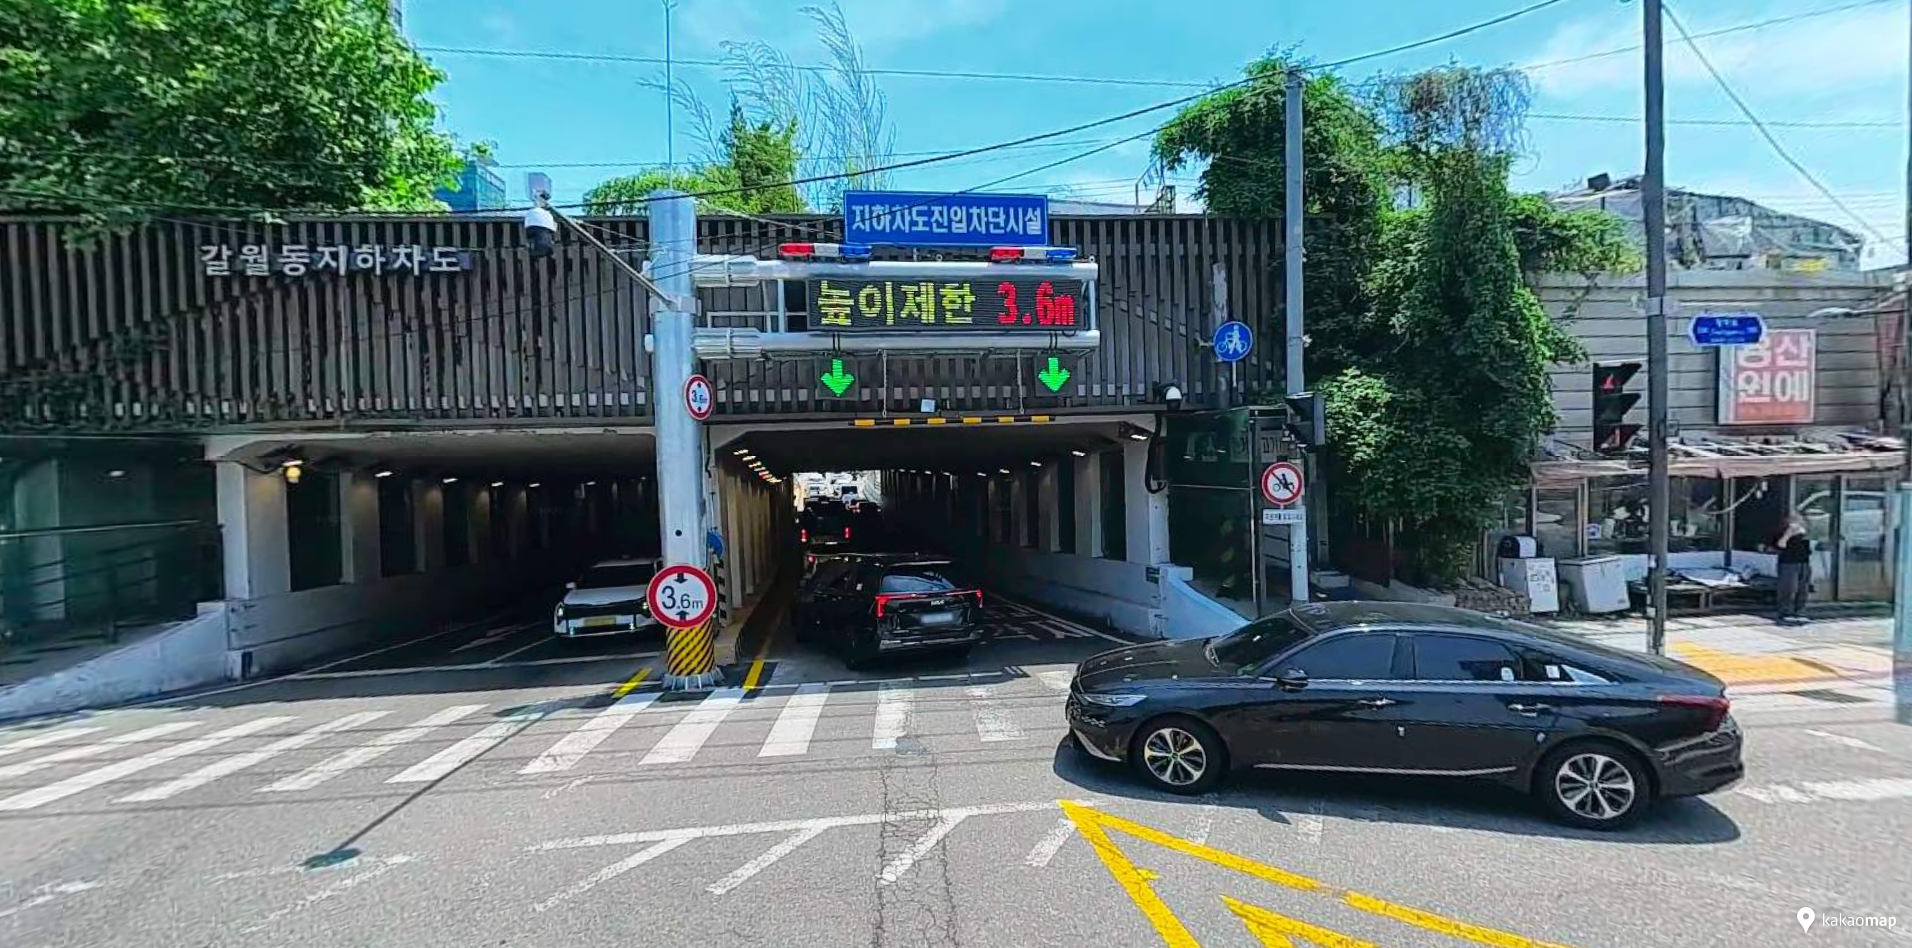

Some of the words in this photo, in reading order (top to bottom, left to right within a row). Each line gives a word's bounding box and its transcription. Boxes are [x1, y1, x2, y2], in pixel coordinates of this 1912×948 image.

[851, 203, 1042, 235] 지하차도진입차단시설
[201, 244, 461, 276] 갈월동지하차도
[818, 280, 976, 326] 높이제한
[996, 280, 1075, 326] 3.6m
[1738, 371, 1809, 402] 원예
[662, 585, 704, 609] 3.6m
